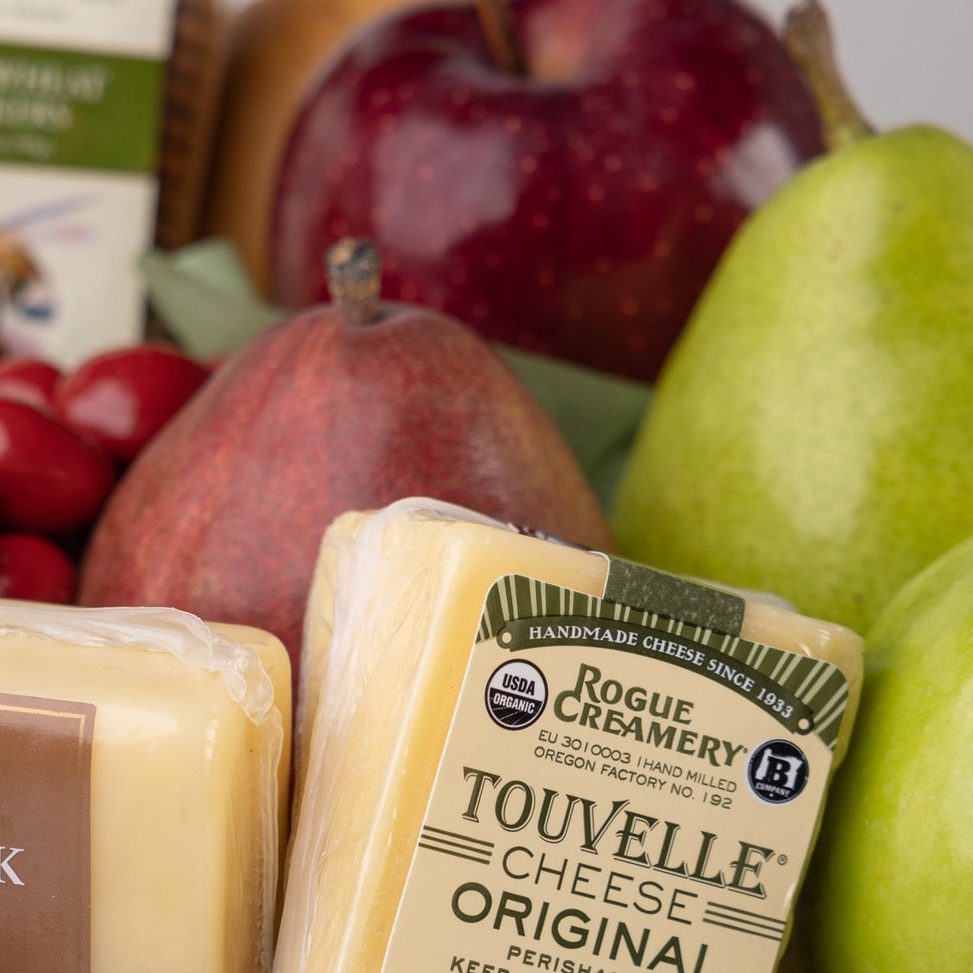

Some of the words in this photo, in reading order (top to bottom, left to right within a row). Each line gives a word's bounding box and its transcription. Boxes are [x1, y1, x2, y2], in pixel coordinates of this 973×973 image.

[493, 693, 536, 714] ORGANIC
[501, 672, 536, 696] USDA
[528, 626, 640, 647] HANDMADE
[642, 635, 704, 667] CHEESE
[706, 656, 756, 692] SINCE
[755, 687, 796, 718] 1933
[573, 662, 695, 726] ROGUE
[552, 689, 744, 767] CREAMERY
[534, 746, 596, 772] OREGON
[600, 764, 666, 790] FACTORY
[670, 783, 695, 800] NO.
[703, 792, 733, 809] 192
[538, 730, 558, 744] EU
[561, 736, 631, 764] 3010003
[644, 758, 682, 778] HAND
[686, 770, 737, 793] MILLED
[755, 782, 792, 799] COMPANY
[462, 766, 775, 898] TOUVELLE
[502, 845, 698, 925] CHEESE
